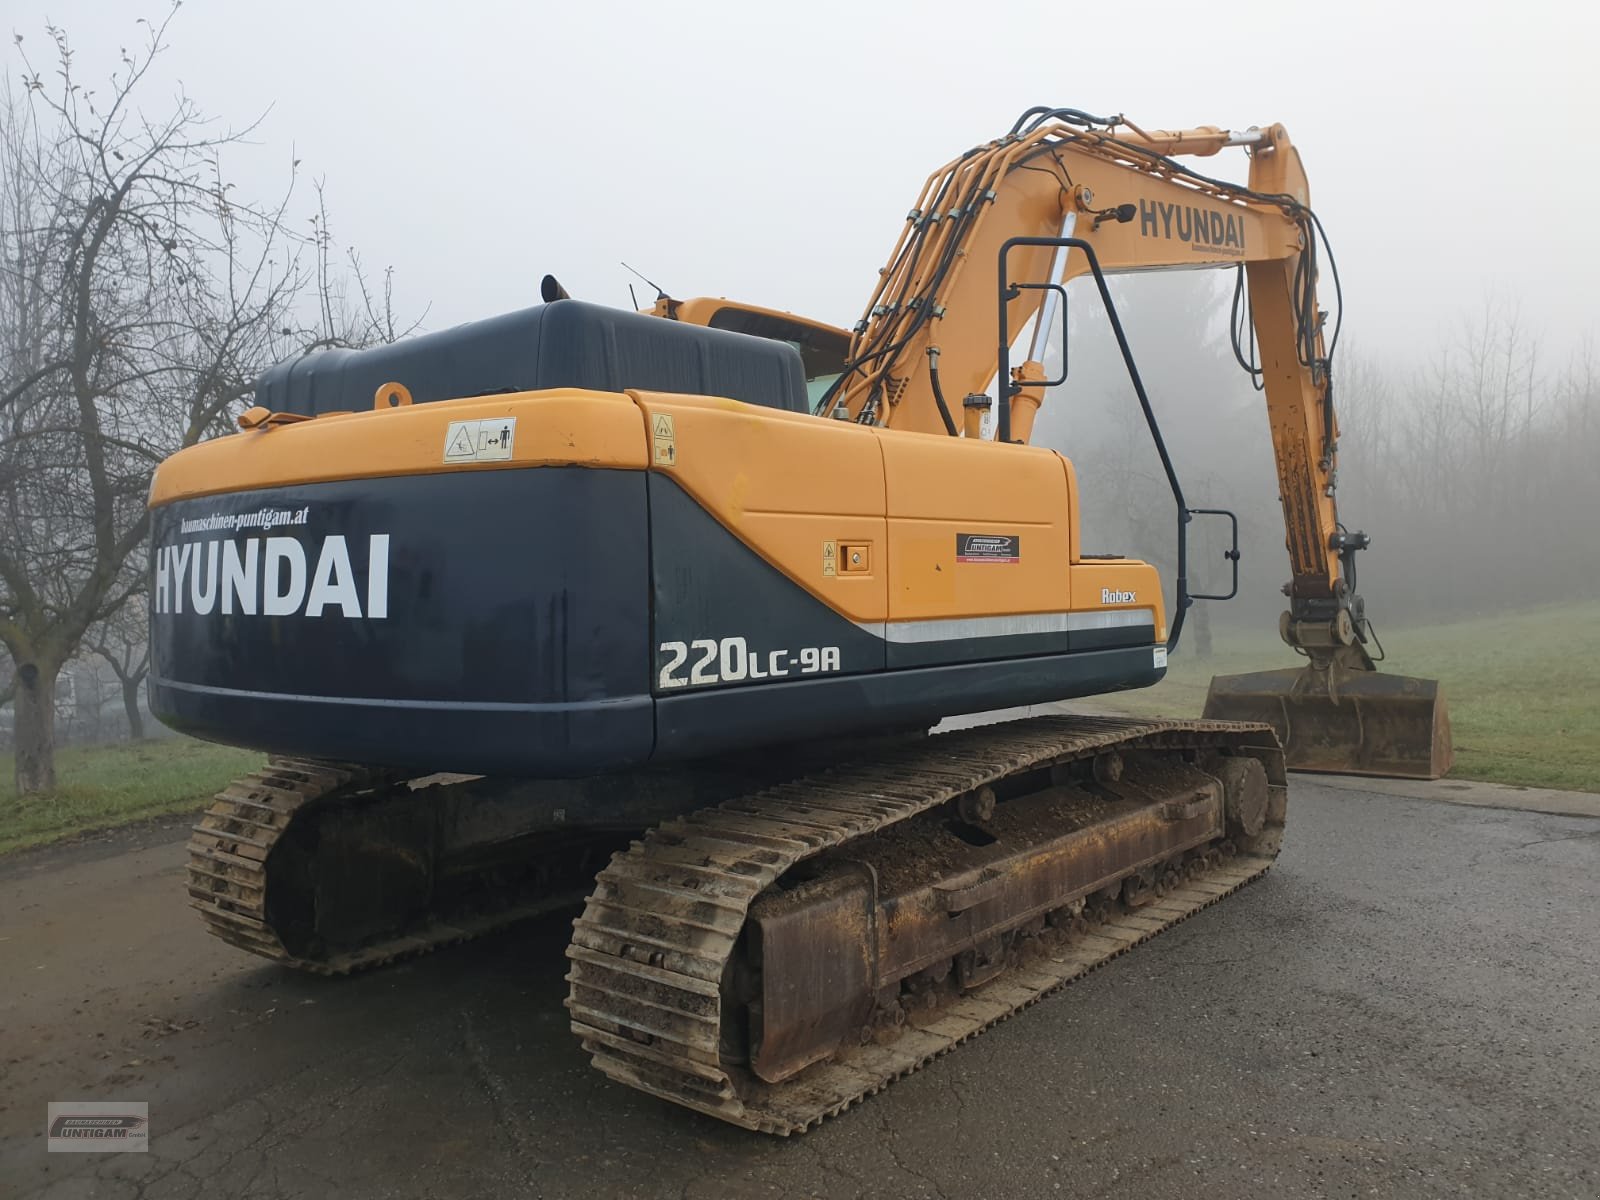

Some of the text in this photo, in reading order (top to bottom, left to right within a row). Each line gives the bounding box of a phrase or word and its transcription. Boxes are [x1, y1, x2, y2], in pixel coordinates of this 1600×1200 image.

[1139, 198, 1245, 249] HYUNDAI
[181, 506, 310, 534] baumaschinen-puntigam.at
[155, 534, 390, 619] HYUNDAI
[1102, 588, 1136, 604] Robex
